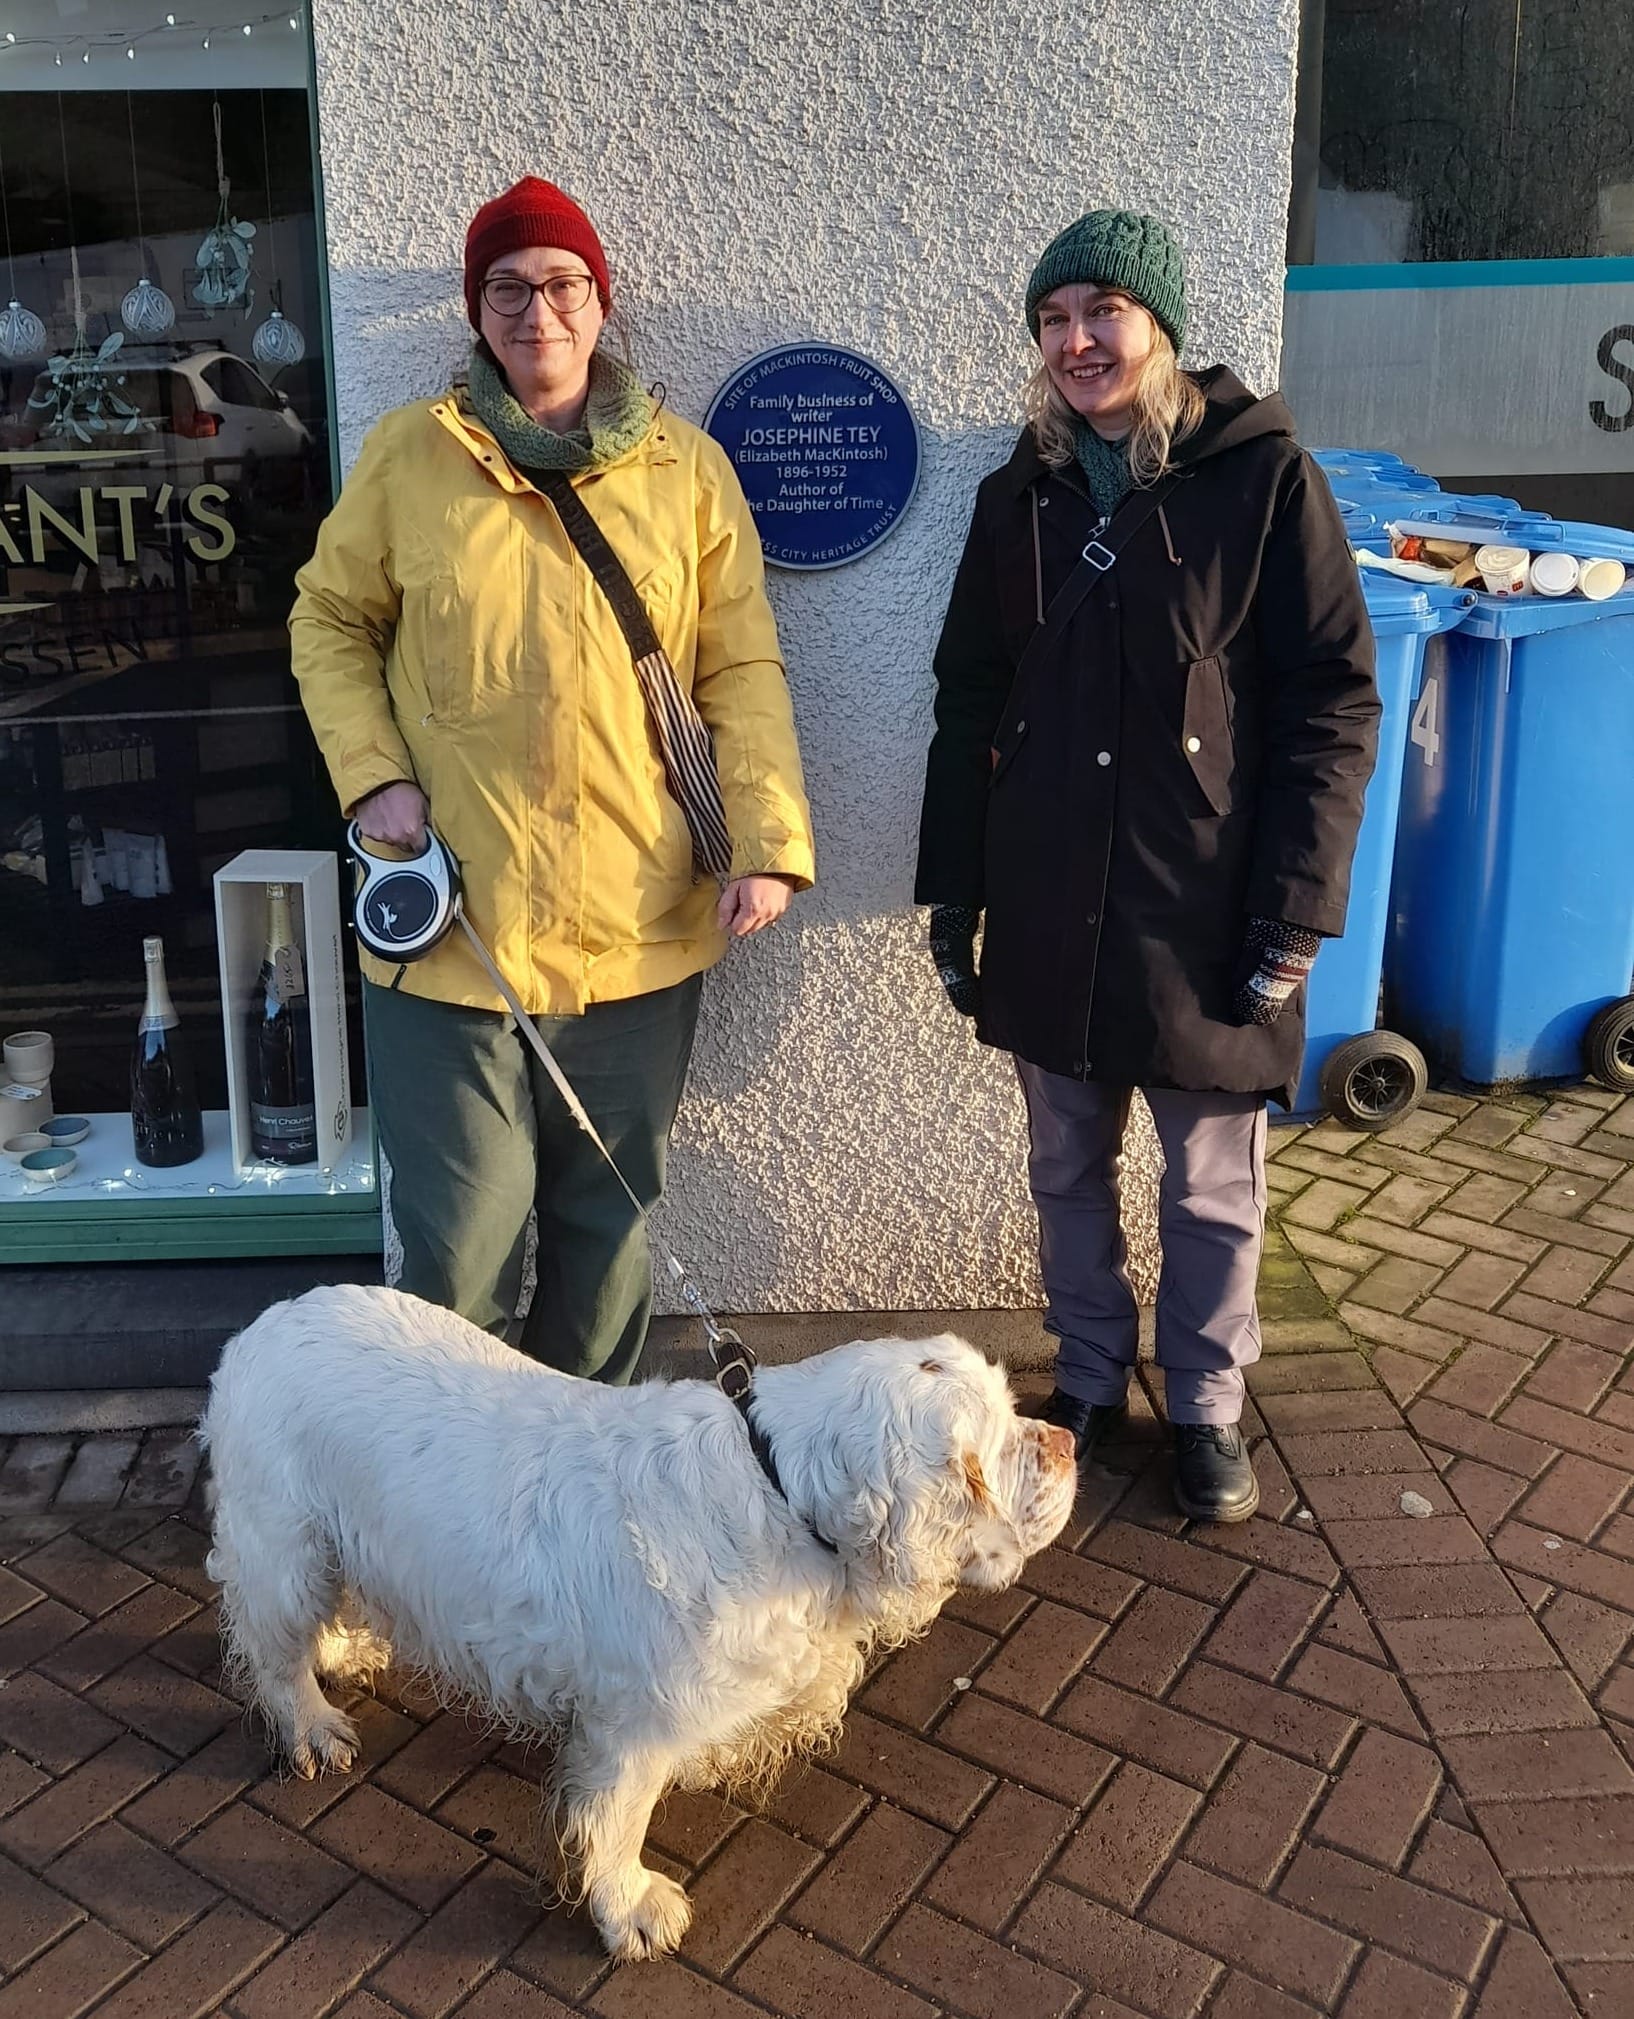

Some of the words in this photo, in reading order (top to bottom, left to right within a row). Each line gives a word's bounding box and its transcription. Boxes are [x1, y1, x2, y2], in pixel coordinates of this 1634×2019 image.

[724, 385, 747, 411] SITE
[743, 371, 759, 389] OF
[759, 352, 838, 379] MACKINTOSH
[839, 357, 874, 381] FRUIT
[870, 376, 898, 405] SHOP
[750, 394, 794, 411] Family
[797, 392, 856, 408] business
[859, 392, 874, 406] of
[791, 409, 832, 423] writer
[741, 427, 843, 446] JOSEPHINE
[846, 425, 881, 443] TEY
[735, 448, 801, 464] (Elizabeth
[804, 446, 888, 462] MacKintosh)
[776, 464, 848, 479] 1896-1952
[779, 482, 826, 496] Author
[829, 481, 844, 495] of
[748, 500, 764, 512] he
[767, 497, 831, 514] Daughter
[834, 497, 848, 510] of
[850, 496, 884, 510] Time
[781, 548, 808, 560] CITY
[812, 534, 868, 561] HERITAGE
[867, 504, 897, 537] TRUST
[1411, 678, 1440, 767] 4
